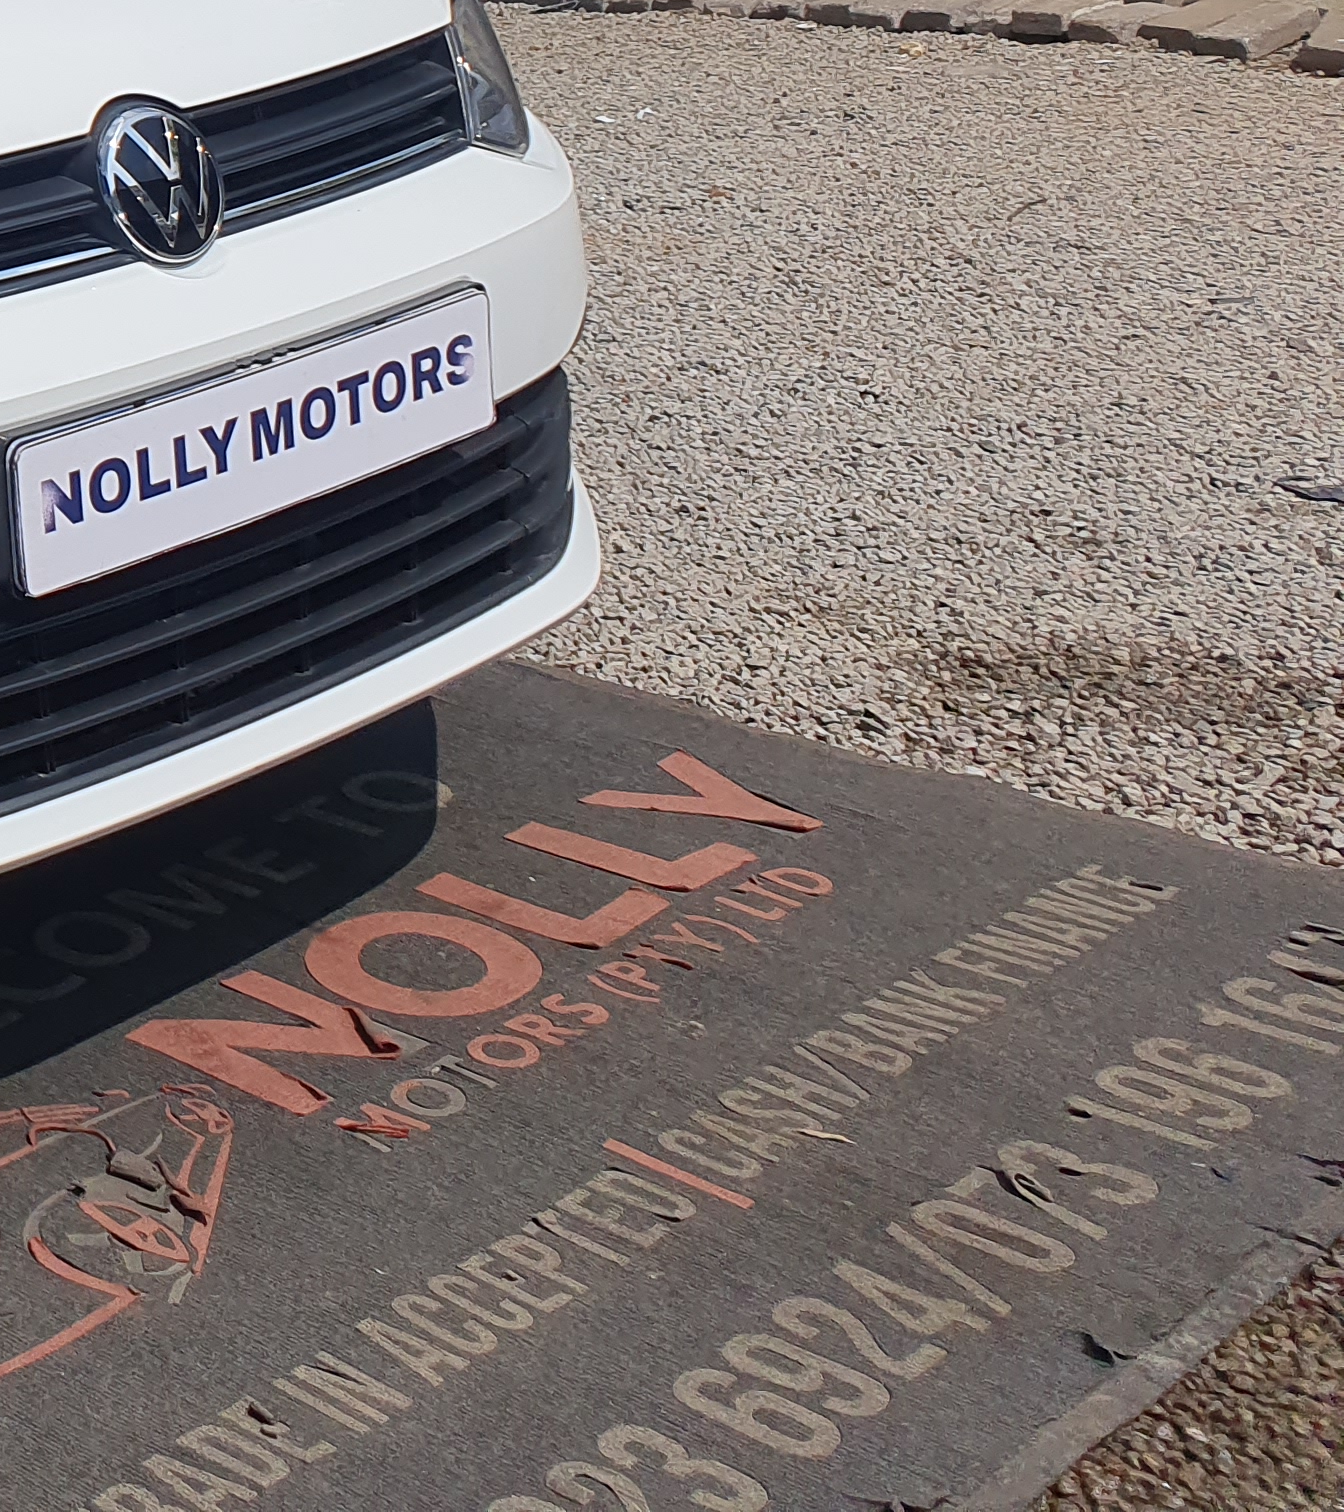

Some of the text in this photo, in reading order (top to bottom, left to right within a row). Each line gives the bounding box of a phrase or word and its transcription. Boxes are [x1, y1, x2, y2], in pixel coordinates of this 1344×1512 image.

[40, 333, 475, 535] NOLLY MOTORS
[272, 768, 439, 838] TO
[124, 749, 824, 1117] NOLLY
[333, 867, 834, 1153] MOTORS (PTY) LTD
[1064, 1036, 1295, 1150] 196
[272, 1350, 413, 1435] IN
[355, 1166, 697, 1388] ACCEPTED
